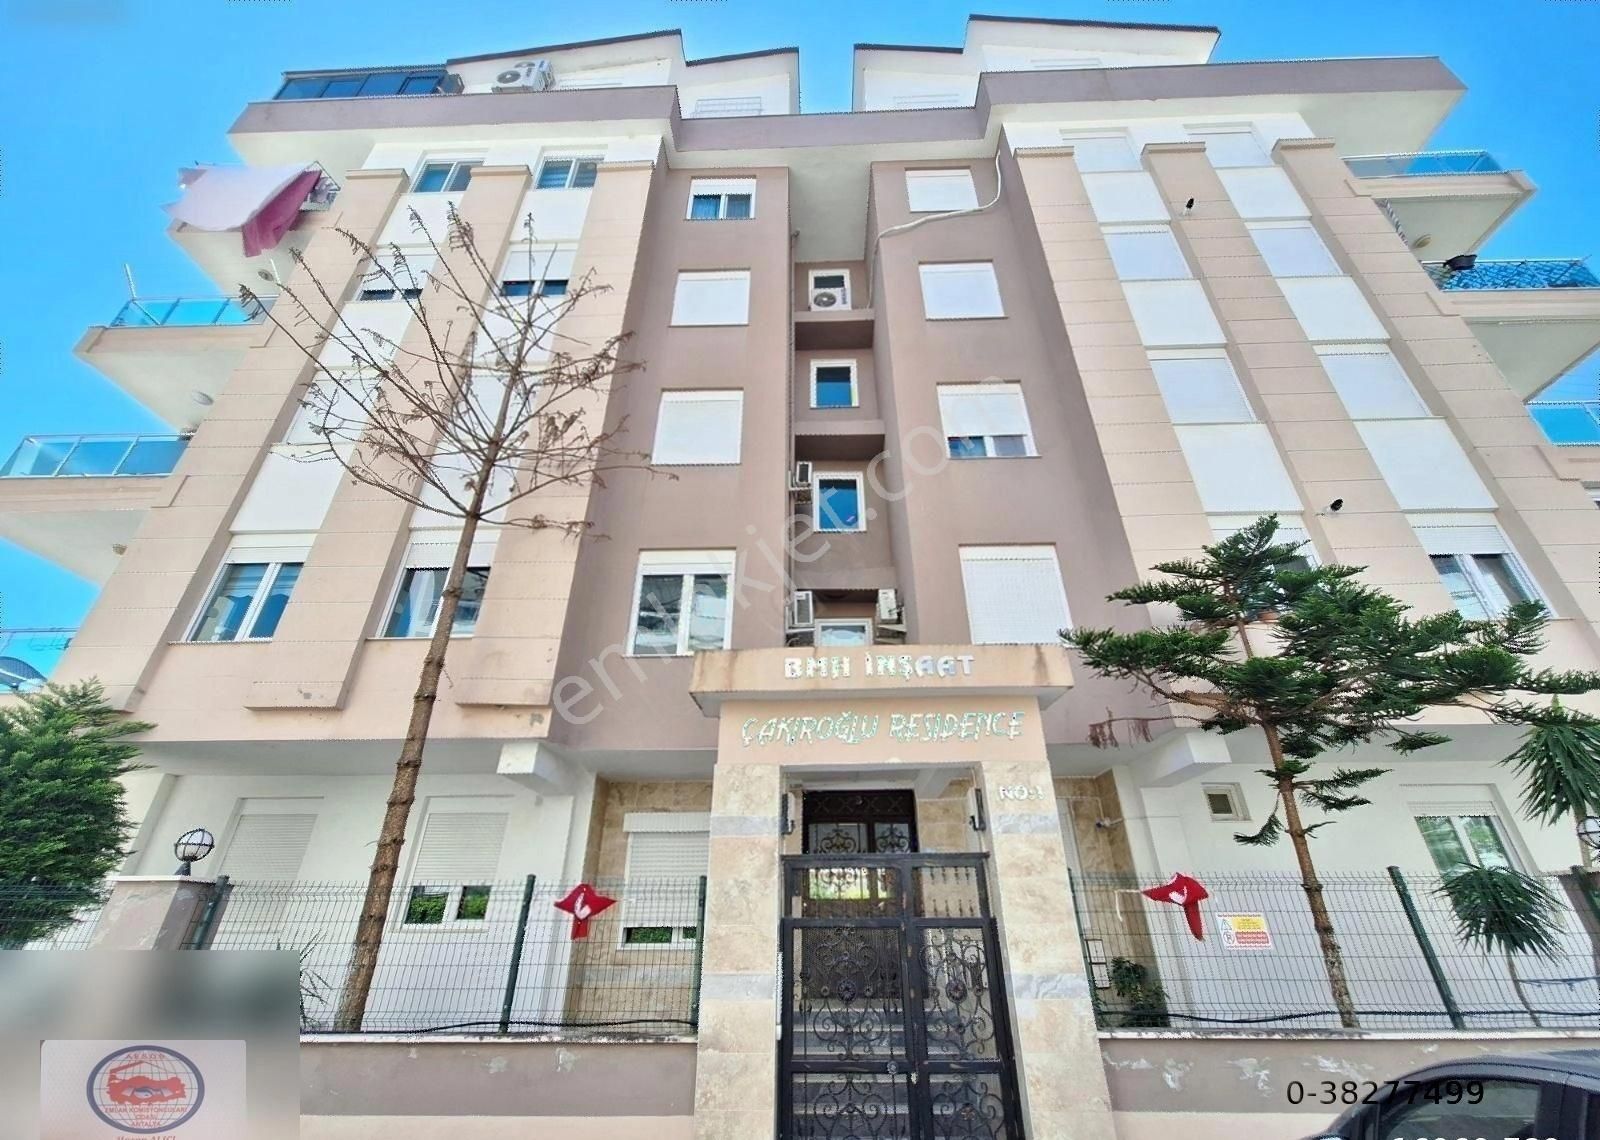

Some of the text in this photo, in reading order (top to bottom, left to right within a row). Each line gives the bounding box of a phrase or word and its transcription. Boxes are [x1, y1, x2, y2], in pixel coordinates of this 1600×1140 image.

[784, 652, 975, 681] BMH İNŞAAT
[741, 711, 1026, 747] ÇAKIROĞLU RESIDENCE
